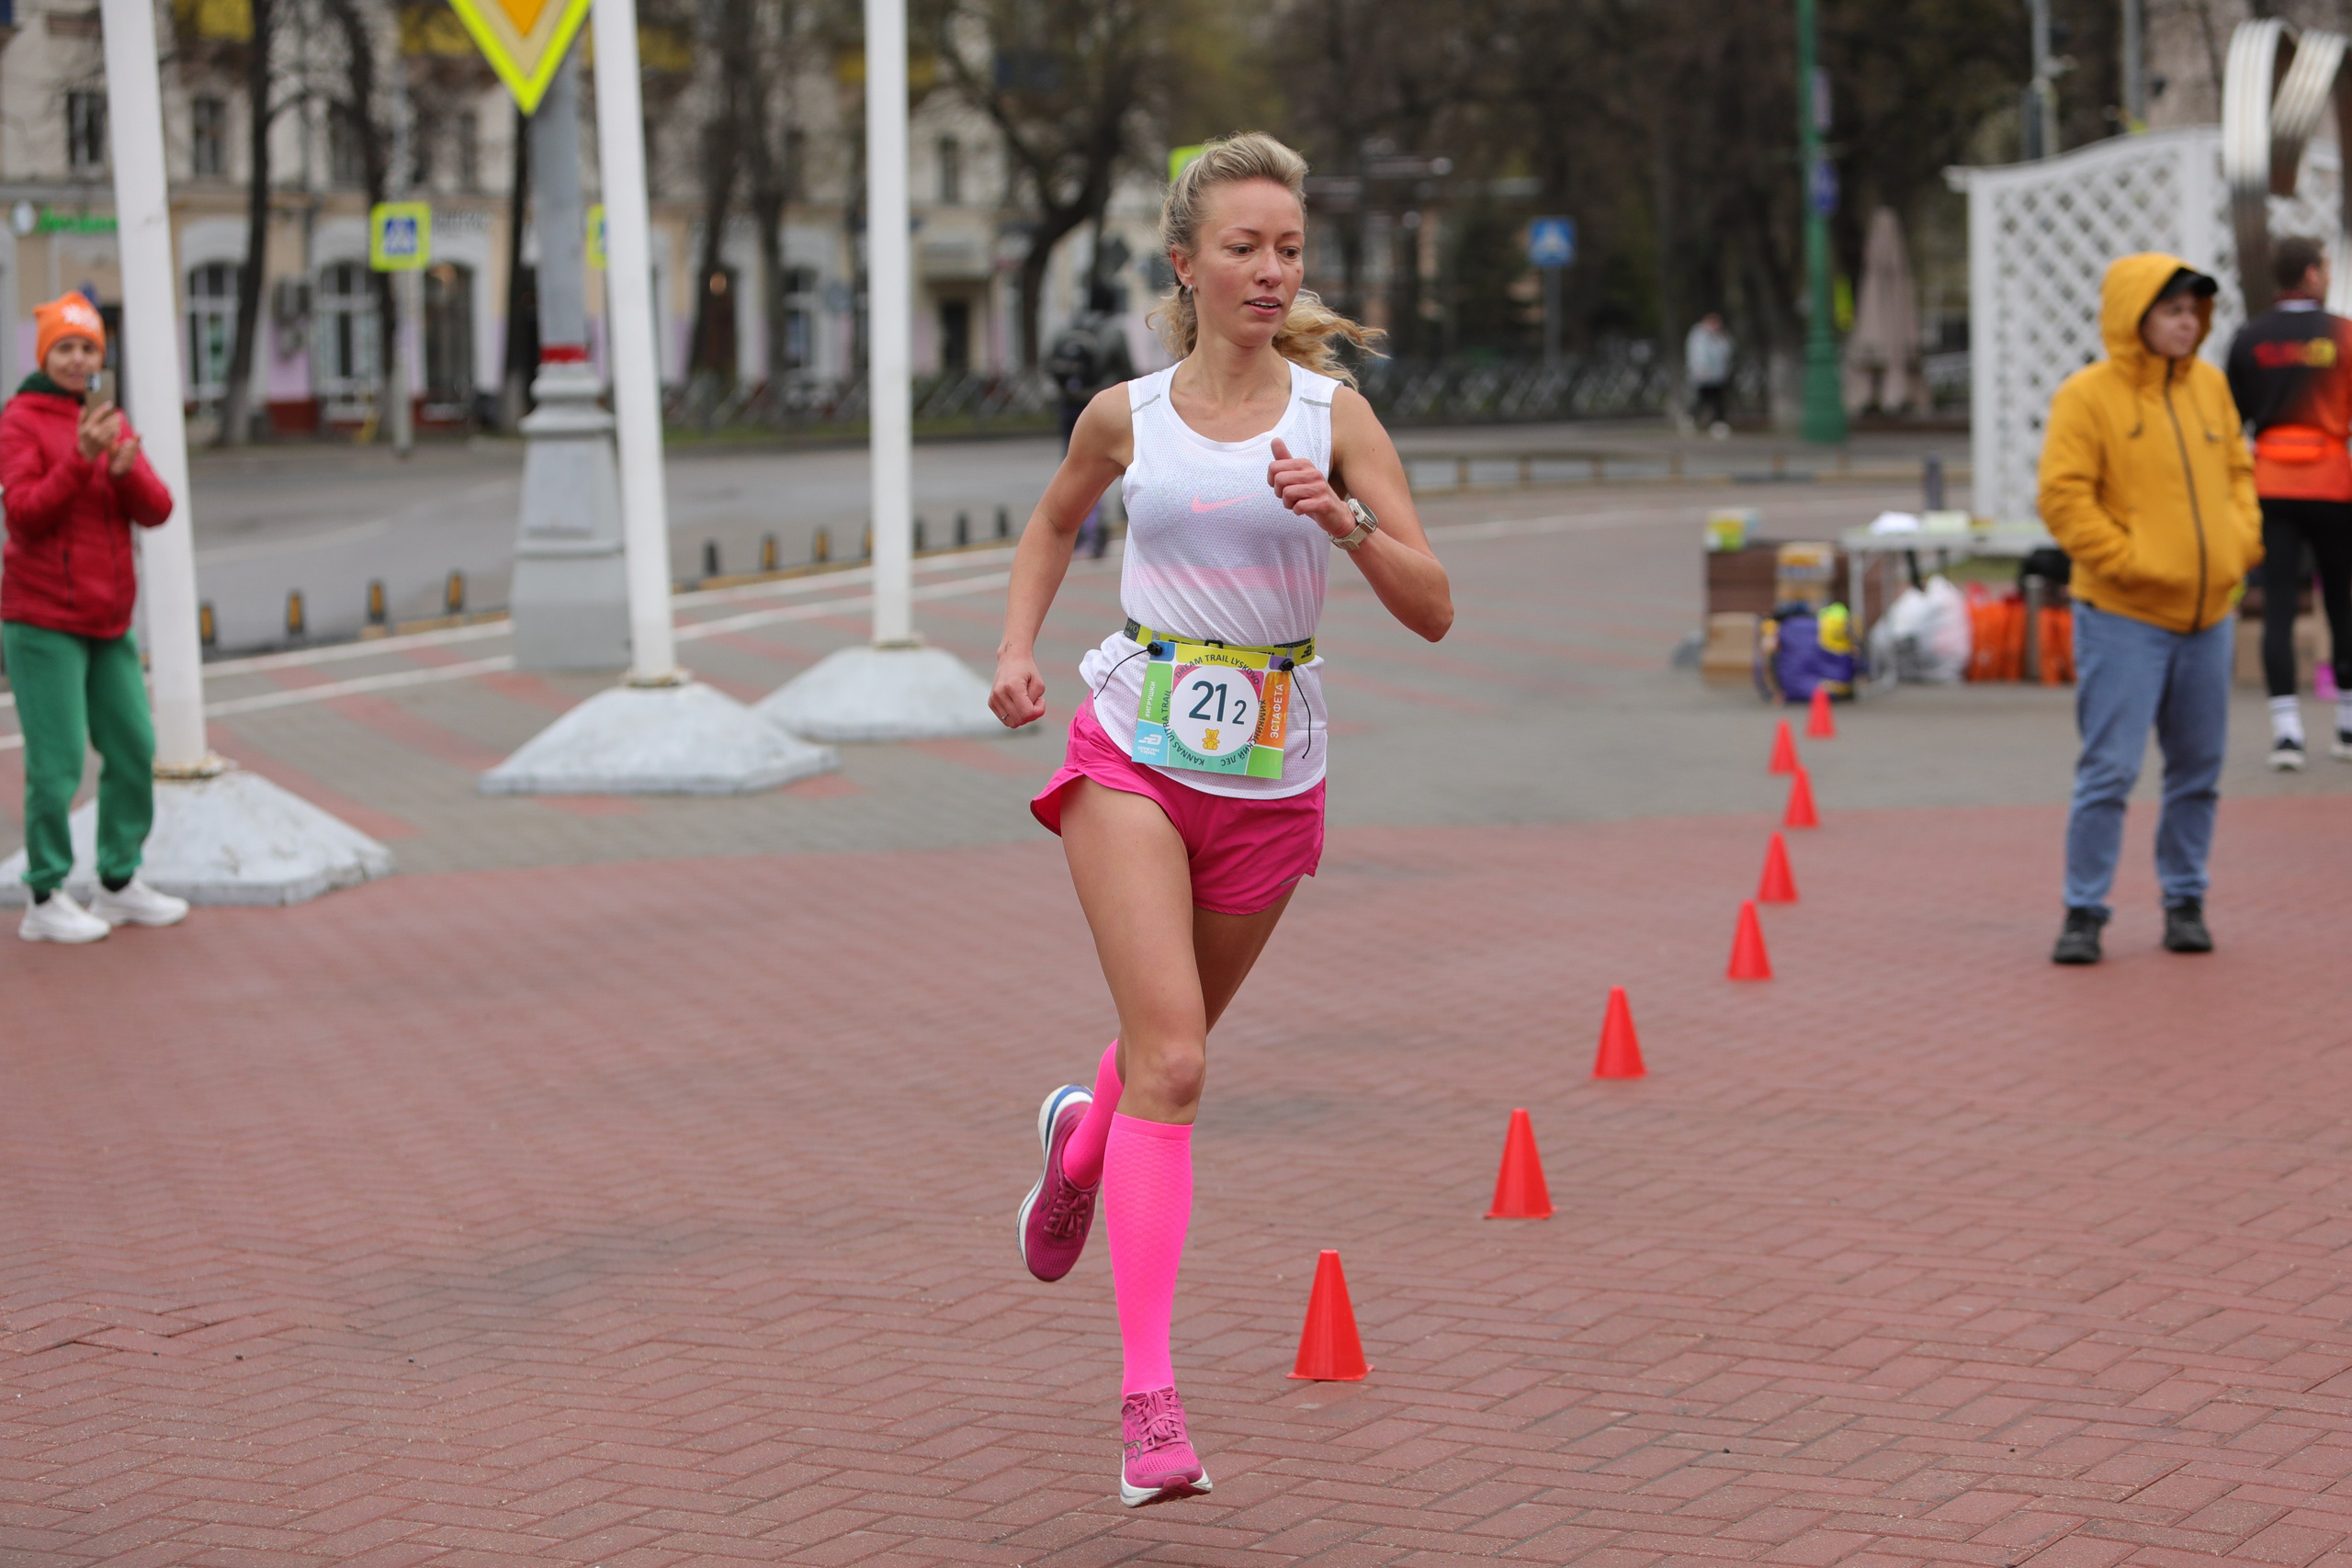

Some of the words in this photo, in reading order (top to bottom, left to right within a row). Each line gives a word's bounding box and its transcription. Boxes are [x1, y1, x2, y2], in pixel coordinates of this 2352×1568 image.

[1175, 656, 1203, 679] DREAM
[1204, 654, 1229, 662] TRAIL
[1231, 657, 1260, 685] LYSKOVO
[1161, 690, 1172, 714] TRAIL
[1189, 680, 1227, 722] 21
[1232, 700, 1247, 725] 2
[1270, 683, 1284, 739] ЭСТАФЕТА
[1238, 699, 1266, 761] ХИМКИНСКИЙ
[1172, 741, 1204, 766] KANNAS
[1220, 756, 1237, 767] ЛЕС
